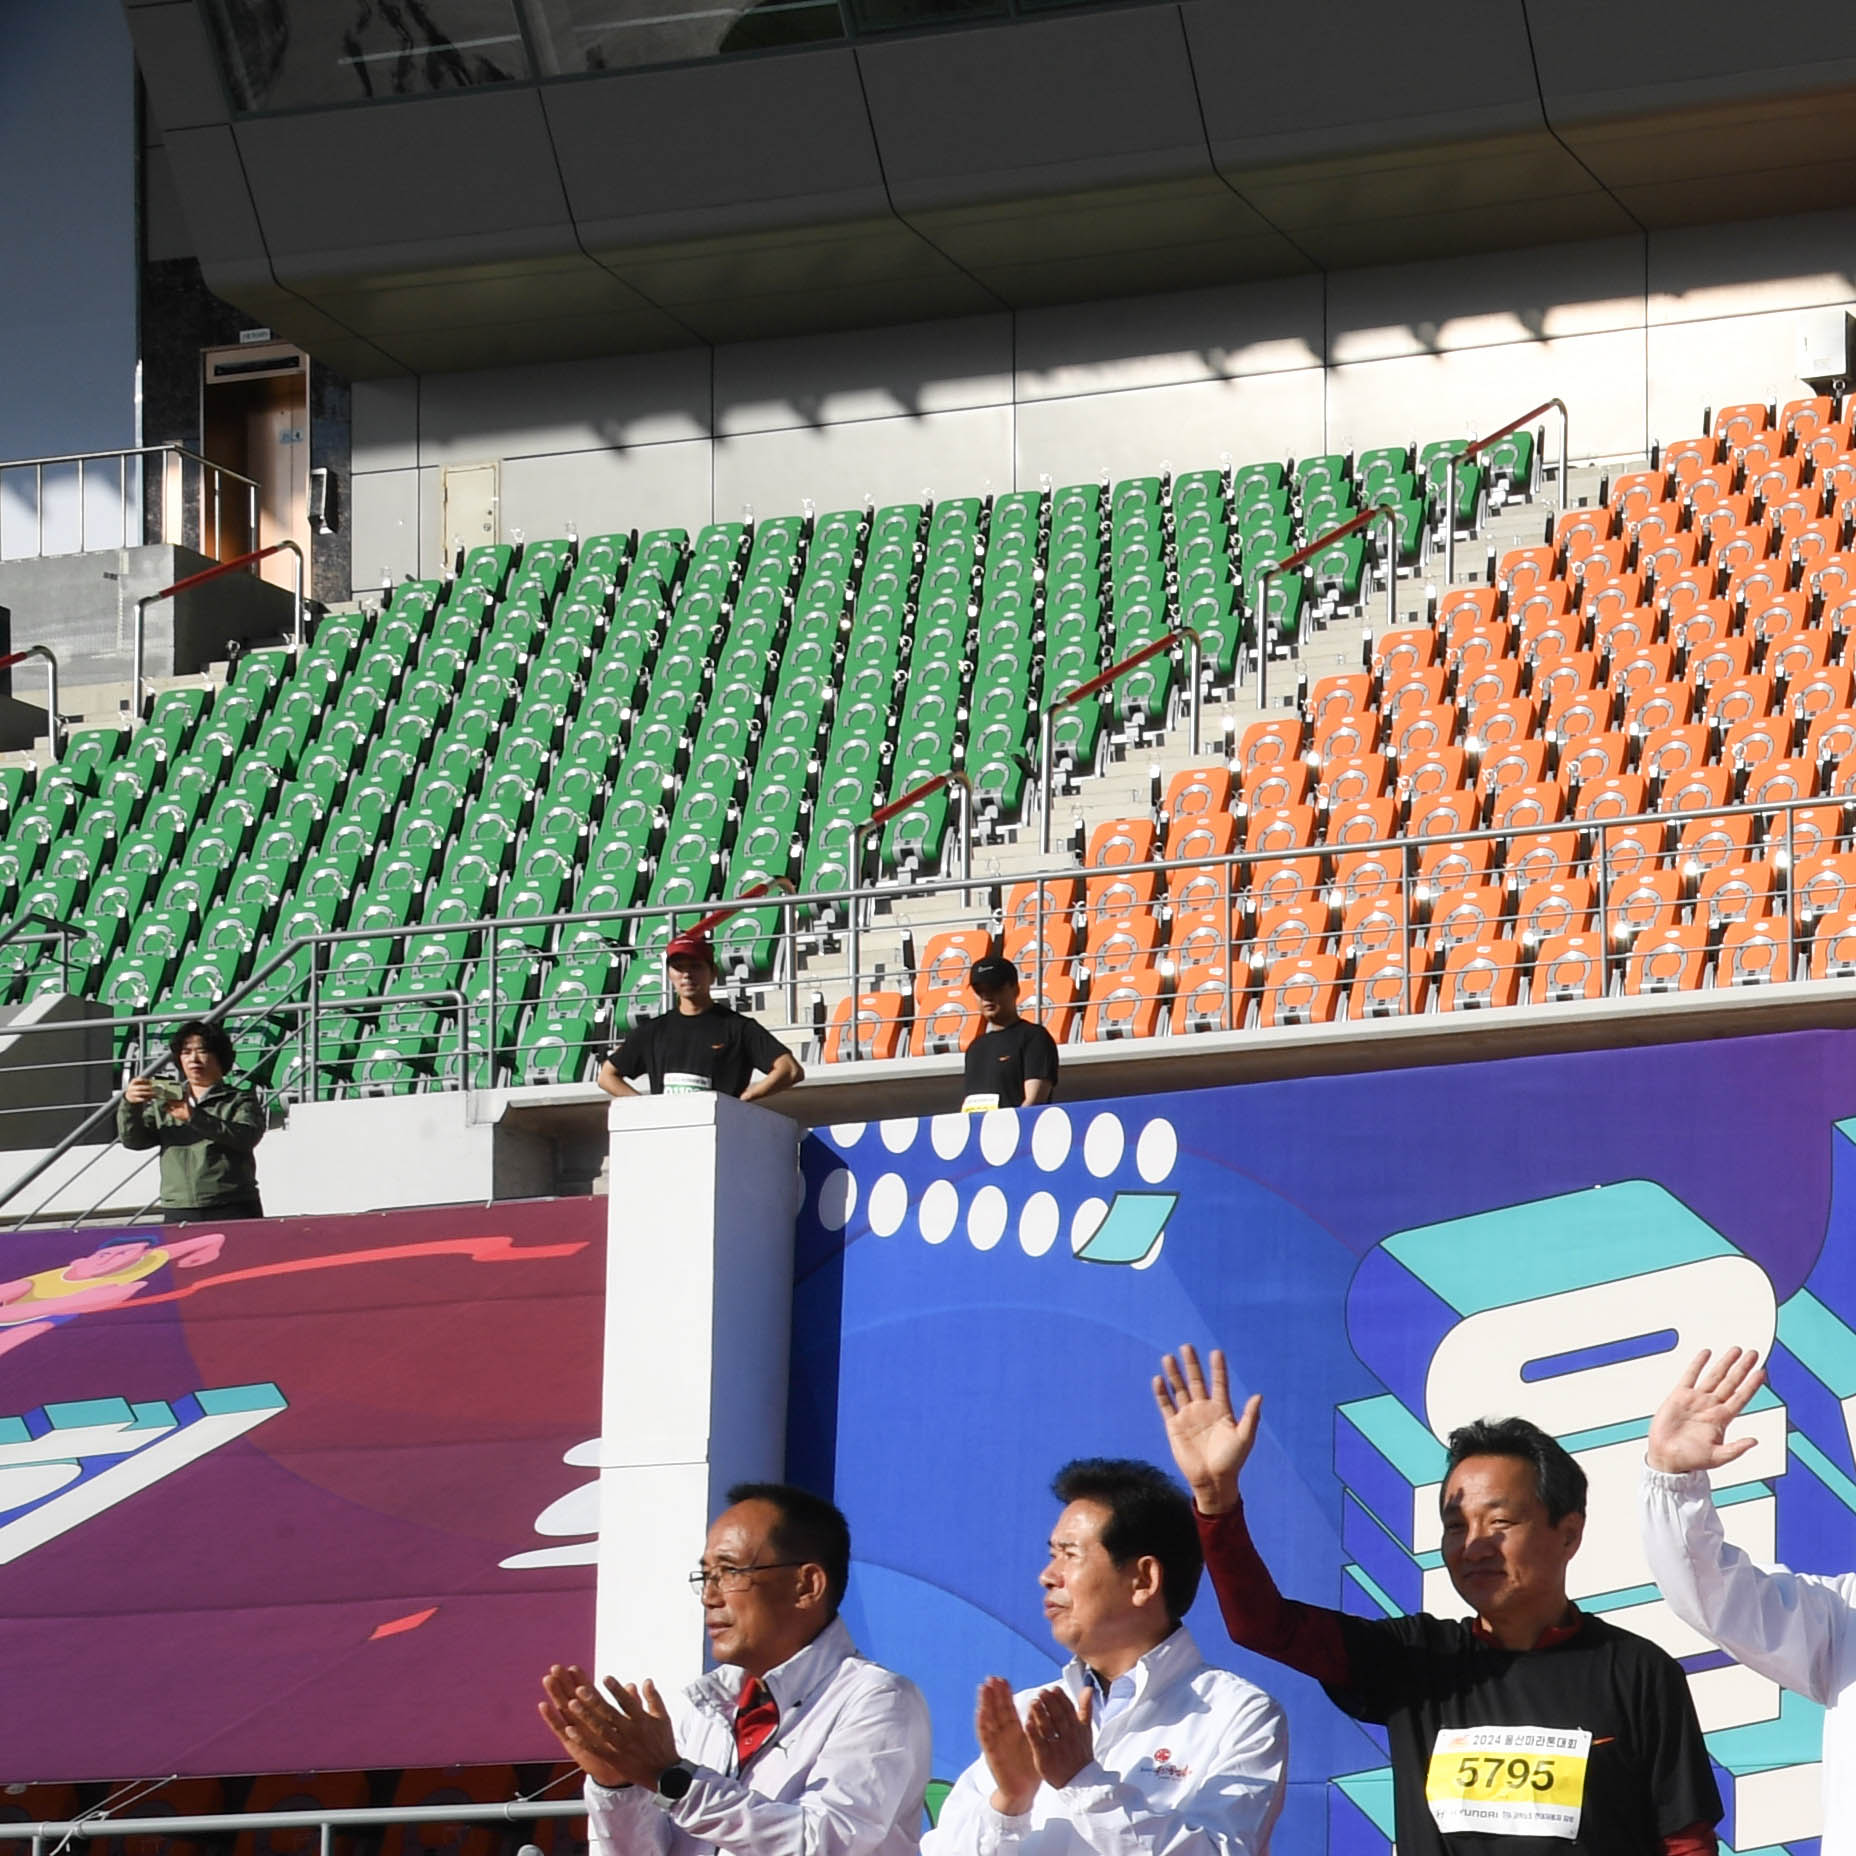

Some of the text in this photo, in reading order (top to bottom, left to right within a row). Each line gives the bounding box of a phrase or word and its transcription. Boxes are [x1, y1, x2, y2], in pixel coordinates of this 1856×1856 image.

[1472, 1734, 1578, 1750] 2024 울산마라톤대회
[1456, 1756, 1556, 1792] 5795
